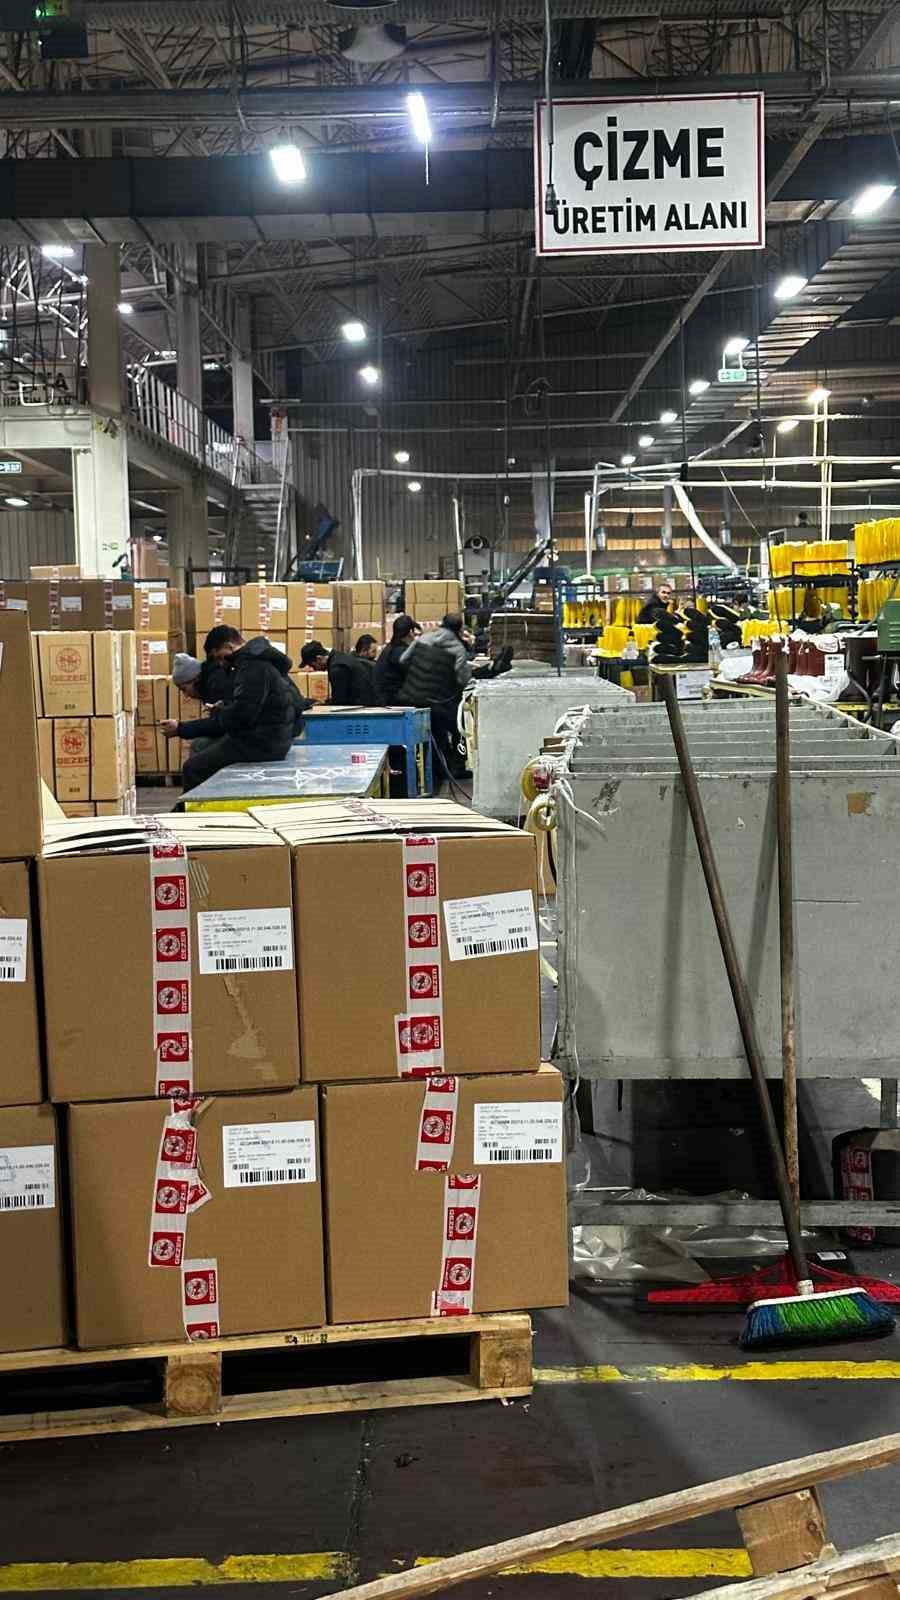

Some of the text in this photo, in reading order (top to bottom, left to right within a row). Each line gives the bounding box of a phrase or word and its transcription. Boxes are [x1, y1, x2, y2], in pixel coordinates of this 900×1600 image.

[573, 116, 724, 191] ÇİZME
[553, 197, 747, 234] ÜRETİM ALANI
